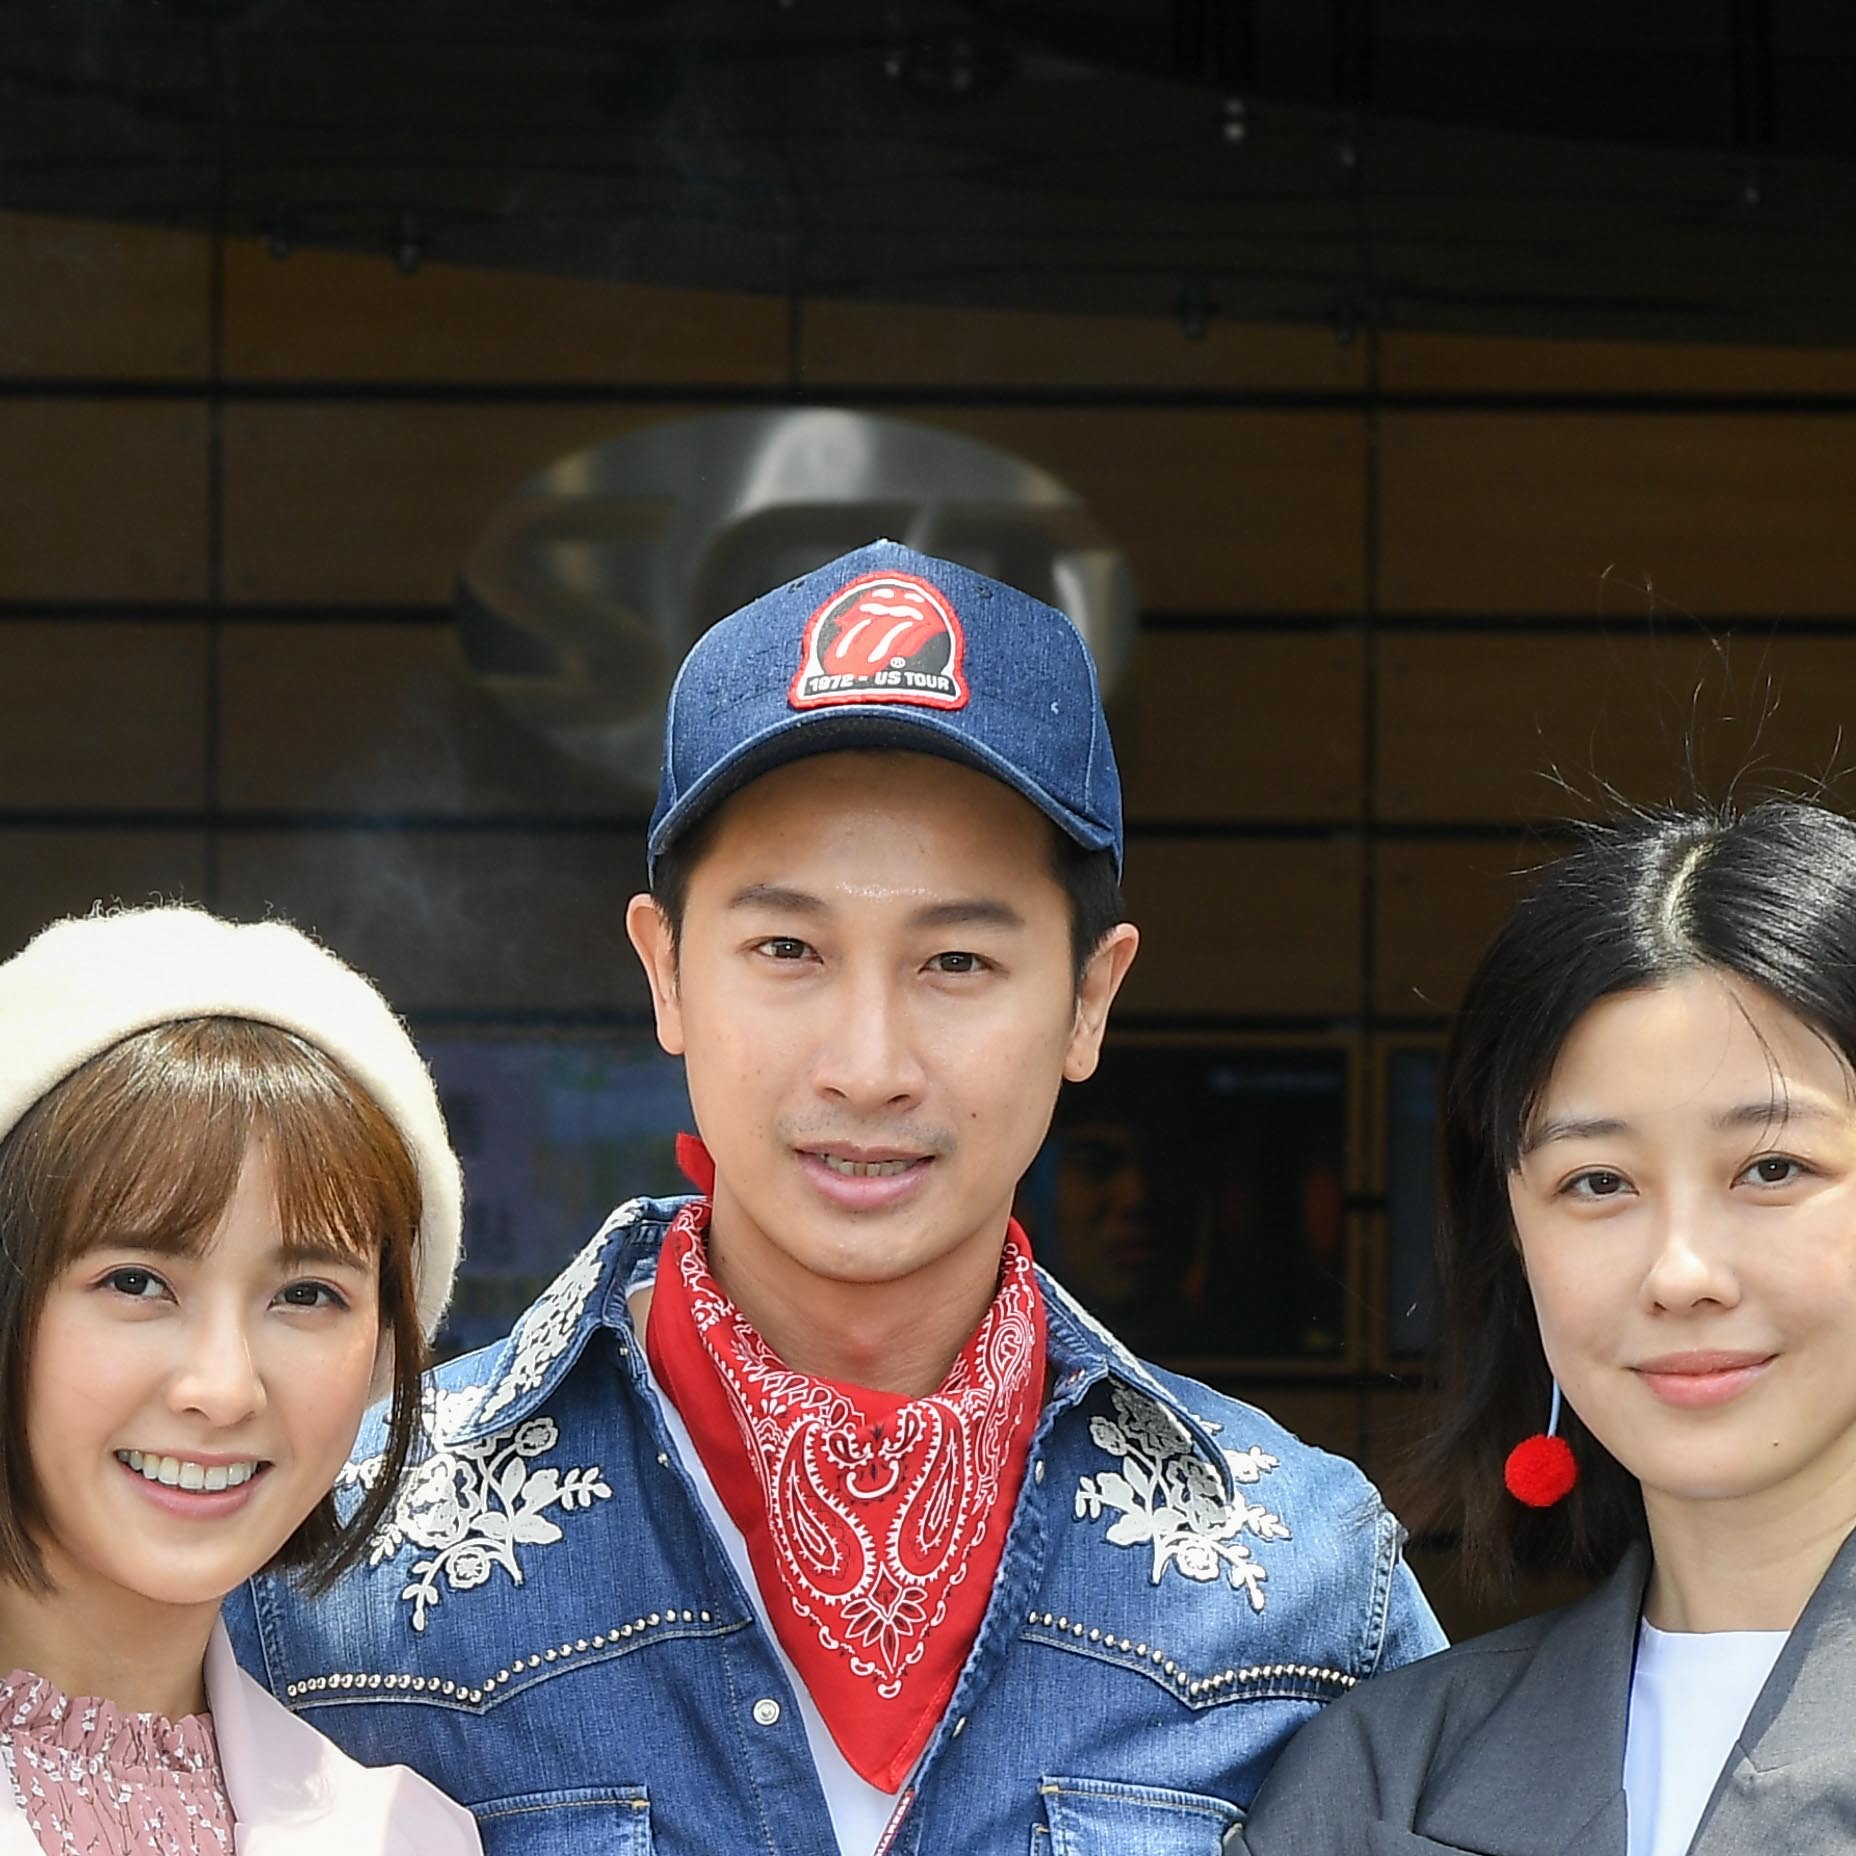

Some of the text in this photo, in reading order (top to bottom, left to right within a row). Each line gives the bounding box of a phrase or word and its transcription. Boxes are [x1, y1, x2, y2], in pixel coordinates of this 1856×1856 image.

[809, 674, 854, 691] 1972
[874, 670, 901, 686] US
[904, 672, 950, 691] TOUR
